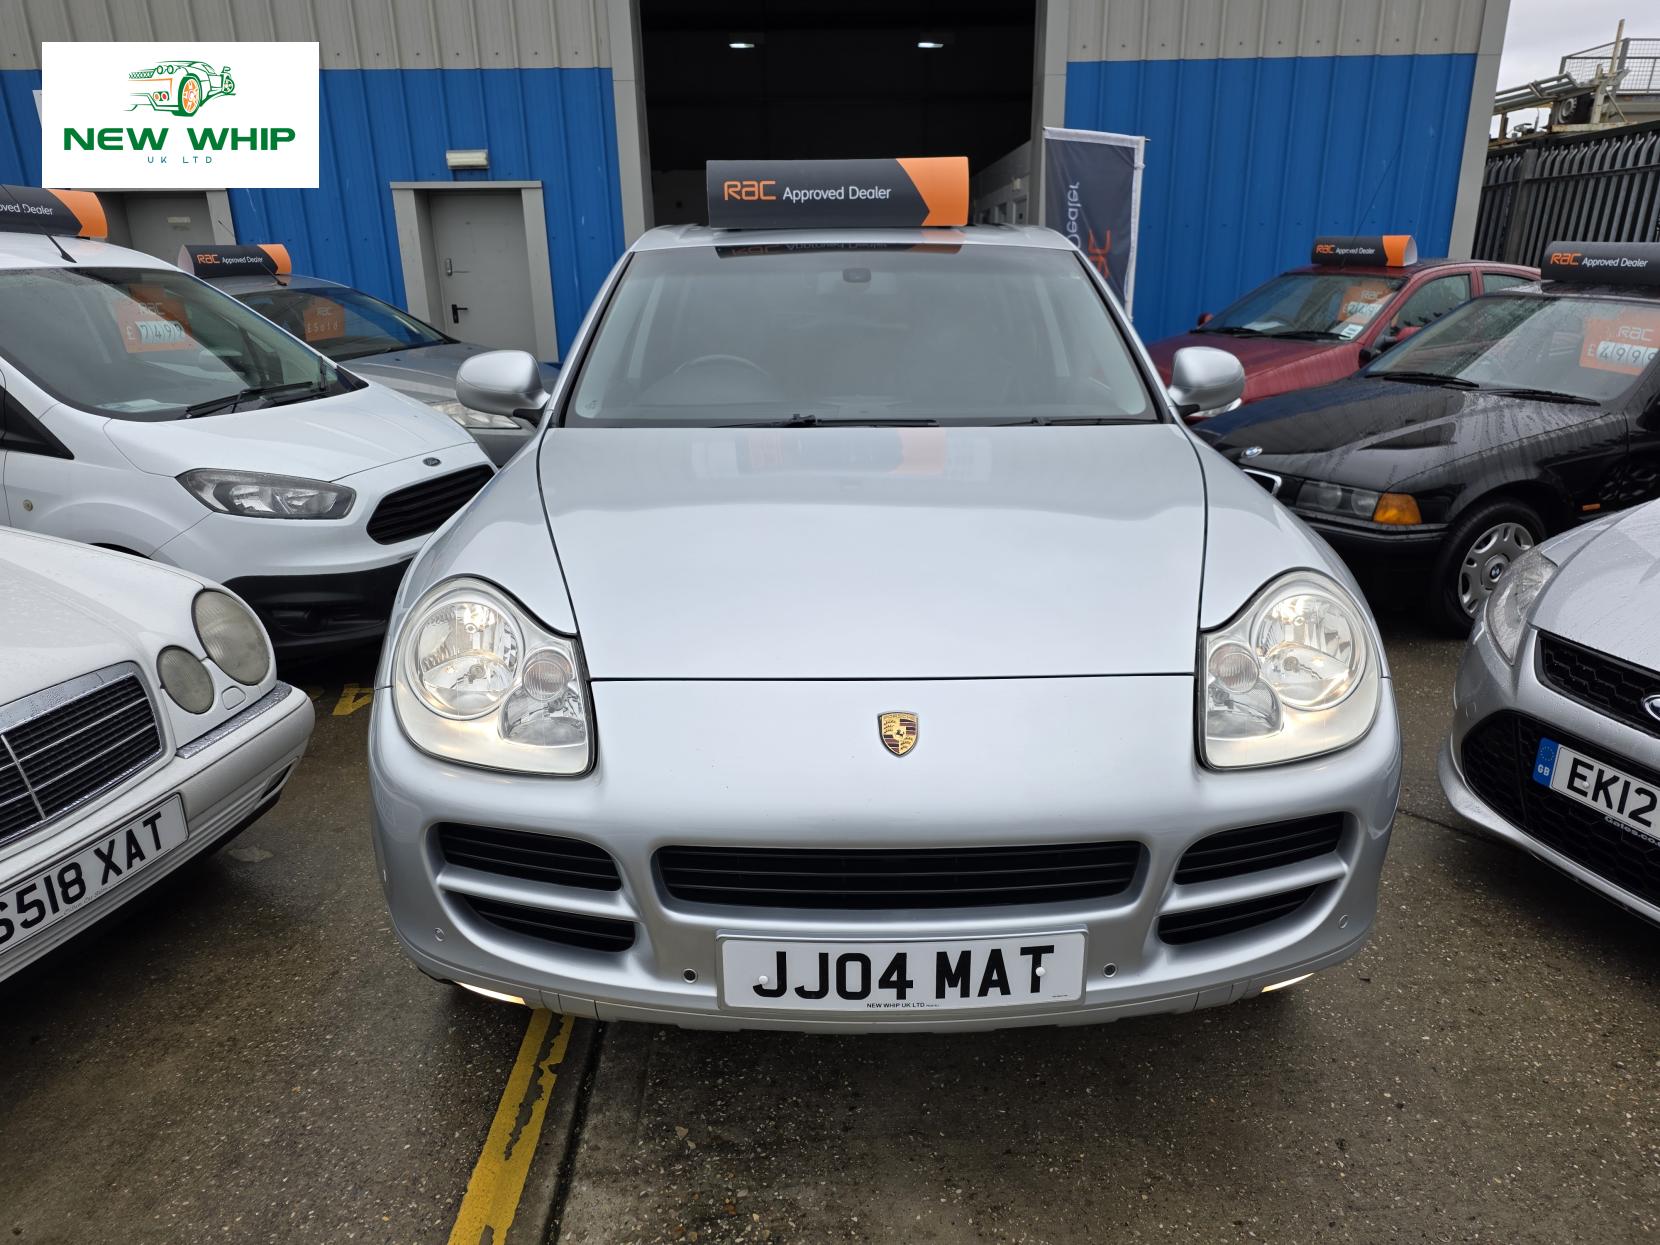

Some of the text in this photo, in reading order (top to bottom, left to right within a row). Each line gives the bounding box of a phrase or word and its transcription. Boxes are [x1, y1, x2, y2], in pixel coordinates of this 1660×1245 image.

[724, 181, 892, 203] RAC Approved Dealer
[22, 204, 53, 215] Dealer
[1336, 247, 1358, 255] Approved
[222, 256, 246, 265] Approved
[1550, 252, 1649, 268] RAC Approved Dealer
[1537, 764, 1551, 776] GB
[1567, 757, 1658, 828] EK12
[0, 811, 162, 946] S518 XAT
[752, 944, 1055, 1000] JJ04 MAT
